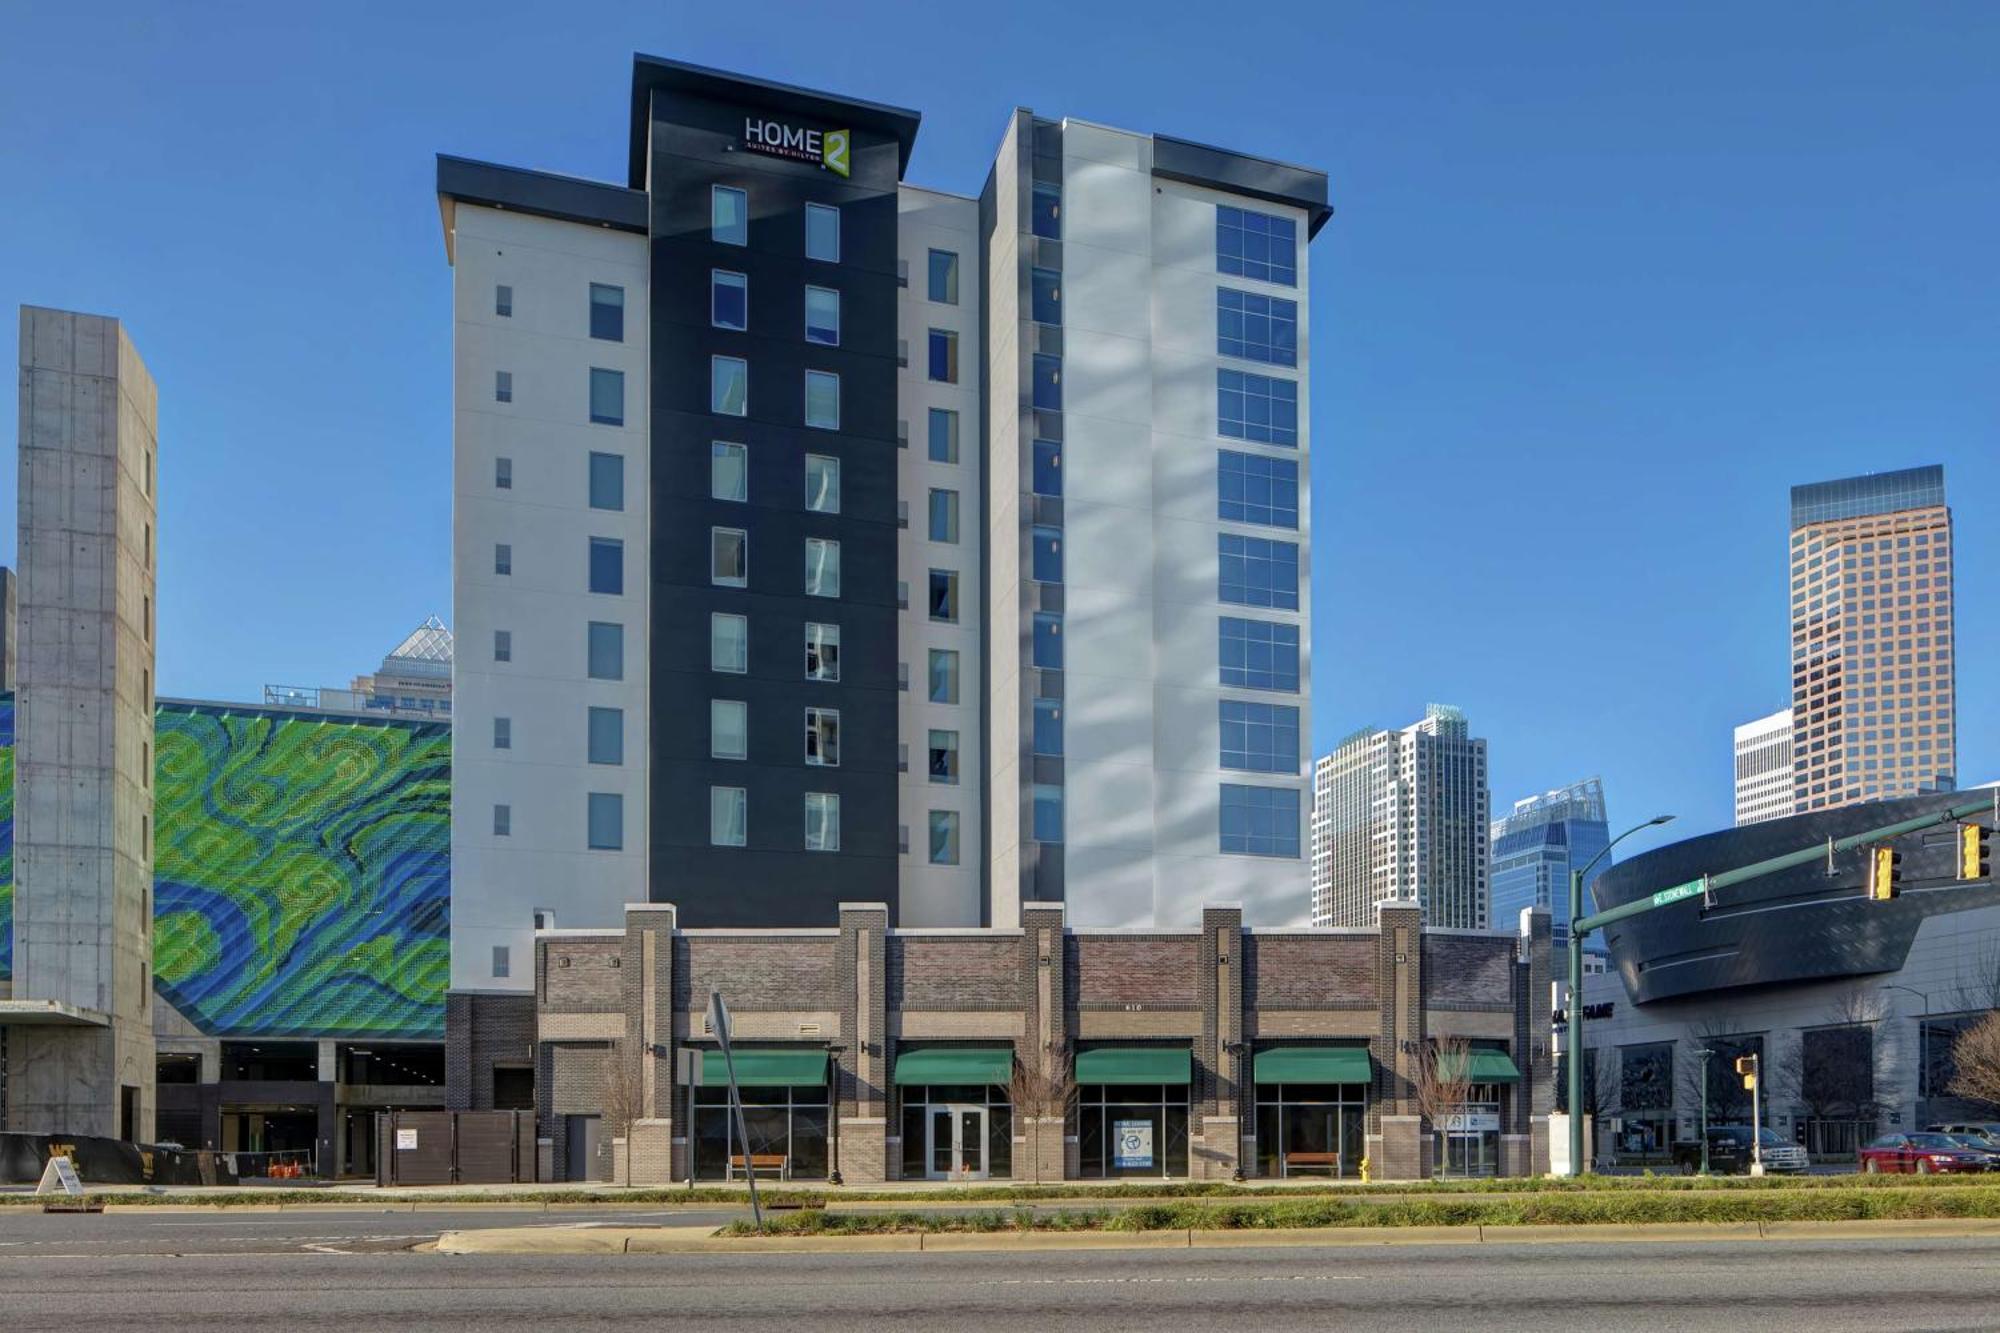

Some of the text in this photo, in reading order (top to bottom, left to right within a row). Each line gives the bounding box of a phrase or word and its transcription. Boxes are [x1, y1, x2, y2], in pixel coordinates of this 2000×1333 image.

[745, 117, 847, 170] HOME 2
[746, 142, 775, 153] SUITES
[791, 151, 822, 161] HILTON
